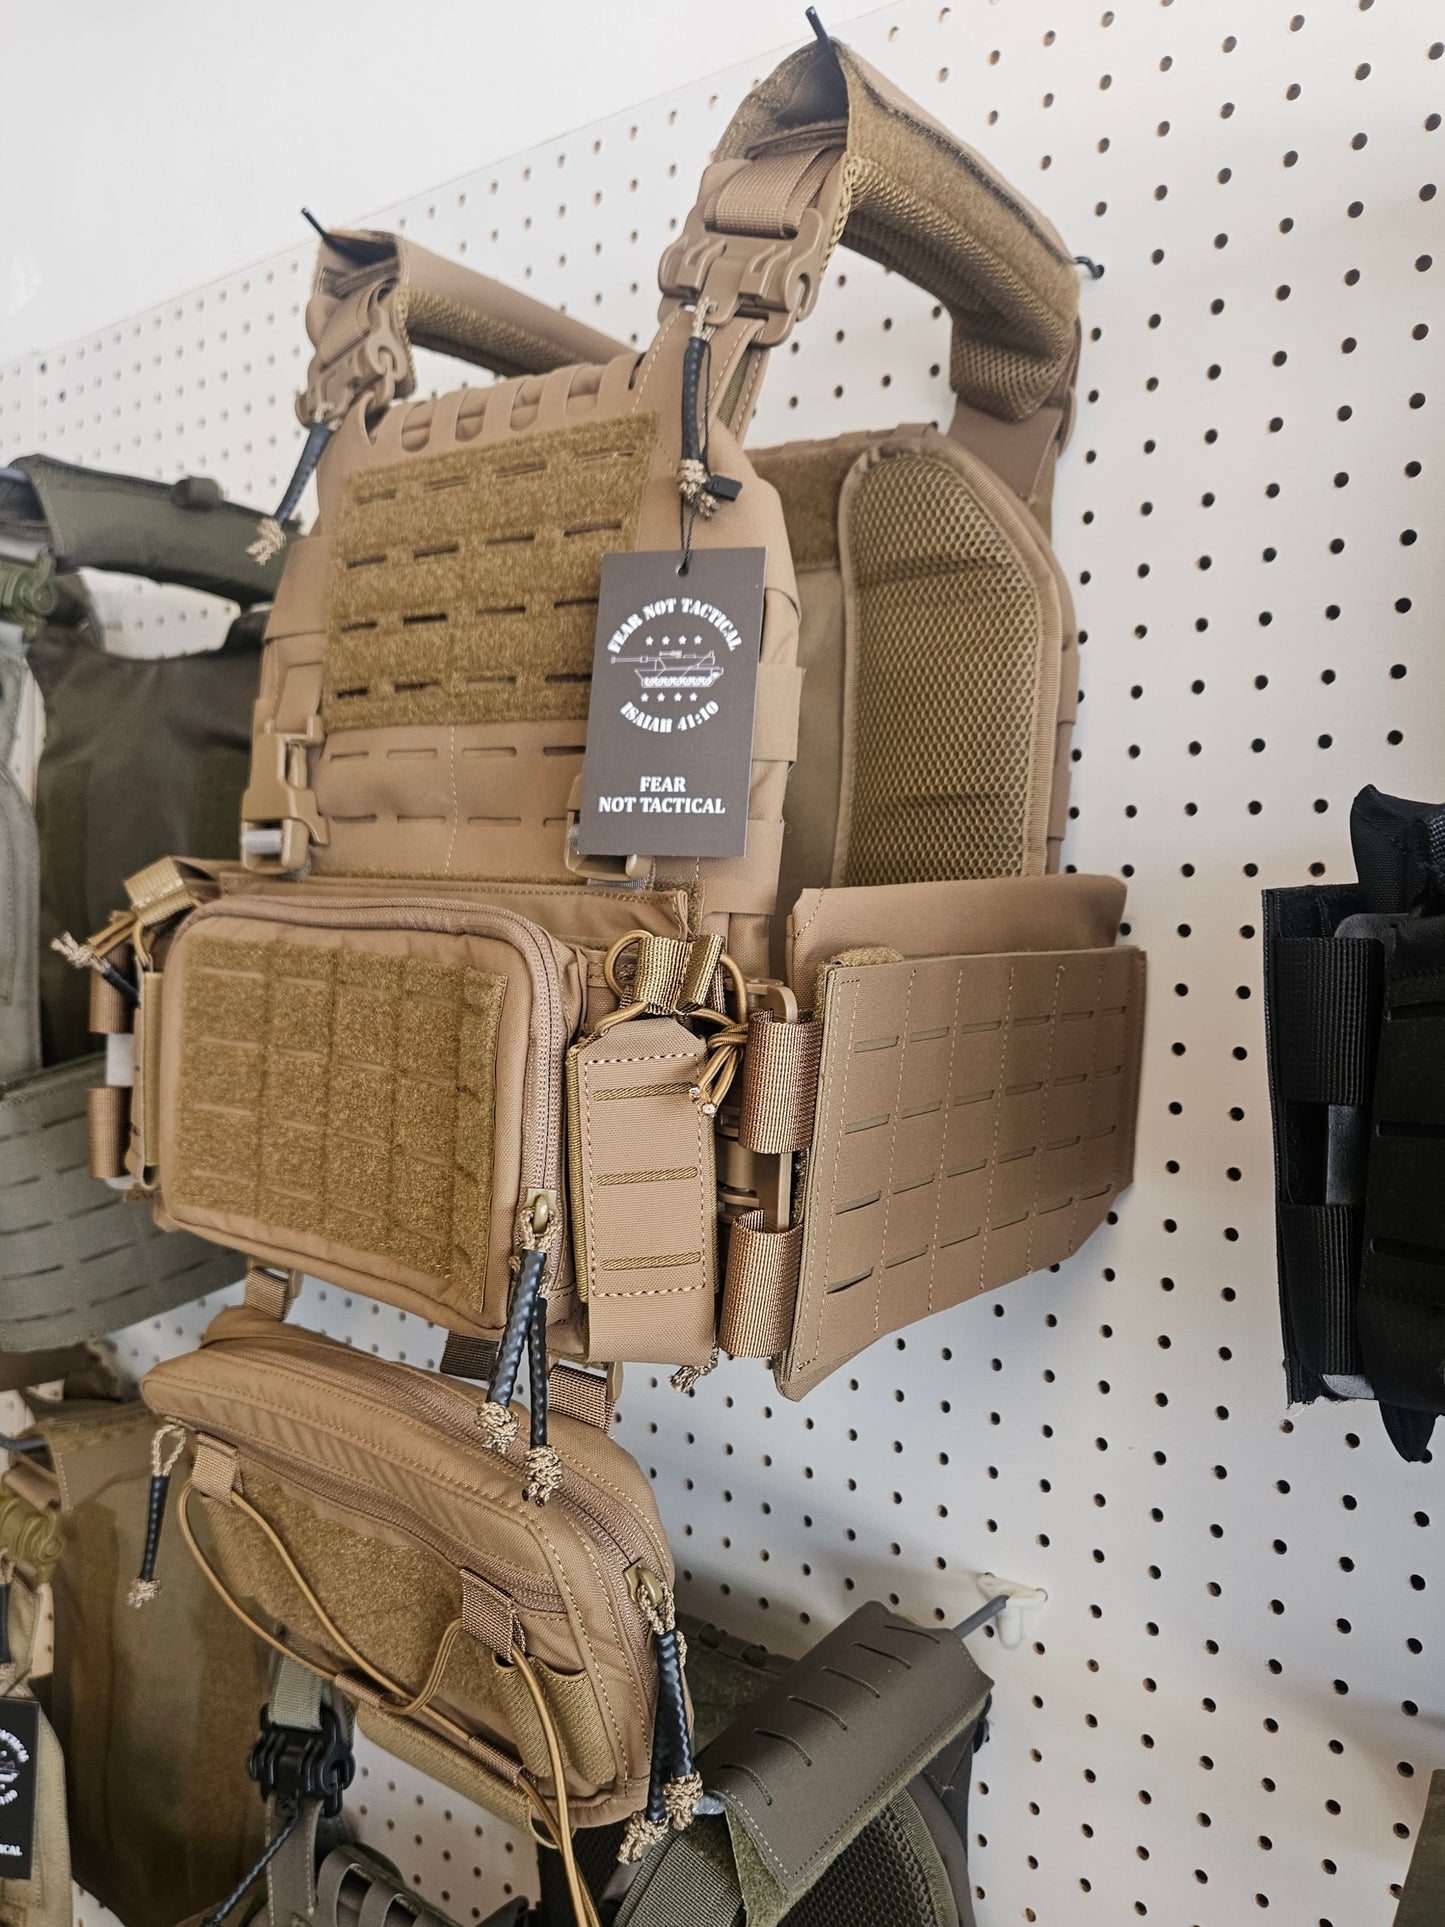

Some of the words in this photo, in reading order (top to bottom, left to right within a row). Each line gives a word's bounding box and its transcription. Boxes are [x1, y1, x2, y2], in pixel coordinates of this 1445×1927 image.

[607, 613, 643, 654] FEAR
[642, 597, 677, 621] NOT
[681, 597, 742, 652] TACTICAL
[620, 701, 673, 733] ISAIAH
[677, 700, 719, 731] 41:10
[639, 775, 687, 793] FEAR
[598, 796, 637, 813] NOT
[640, 797, 726, 814] TACTICAL
